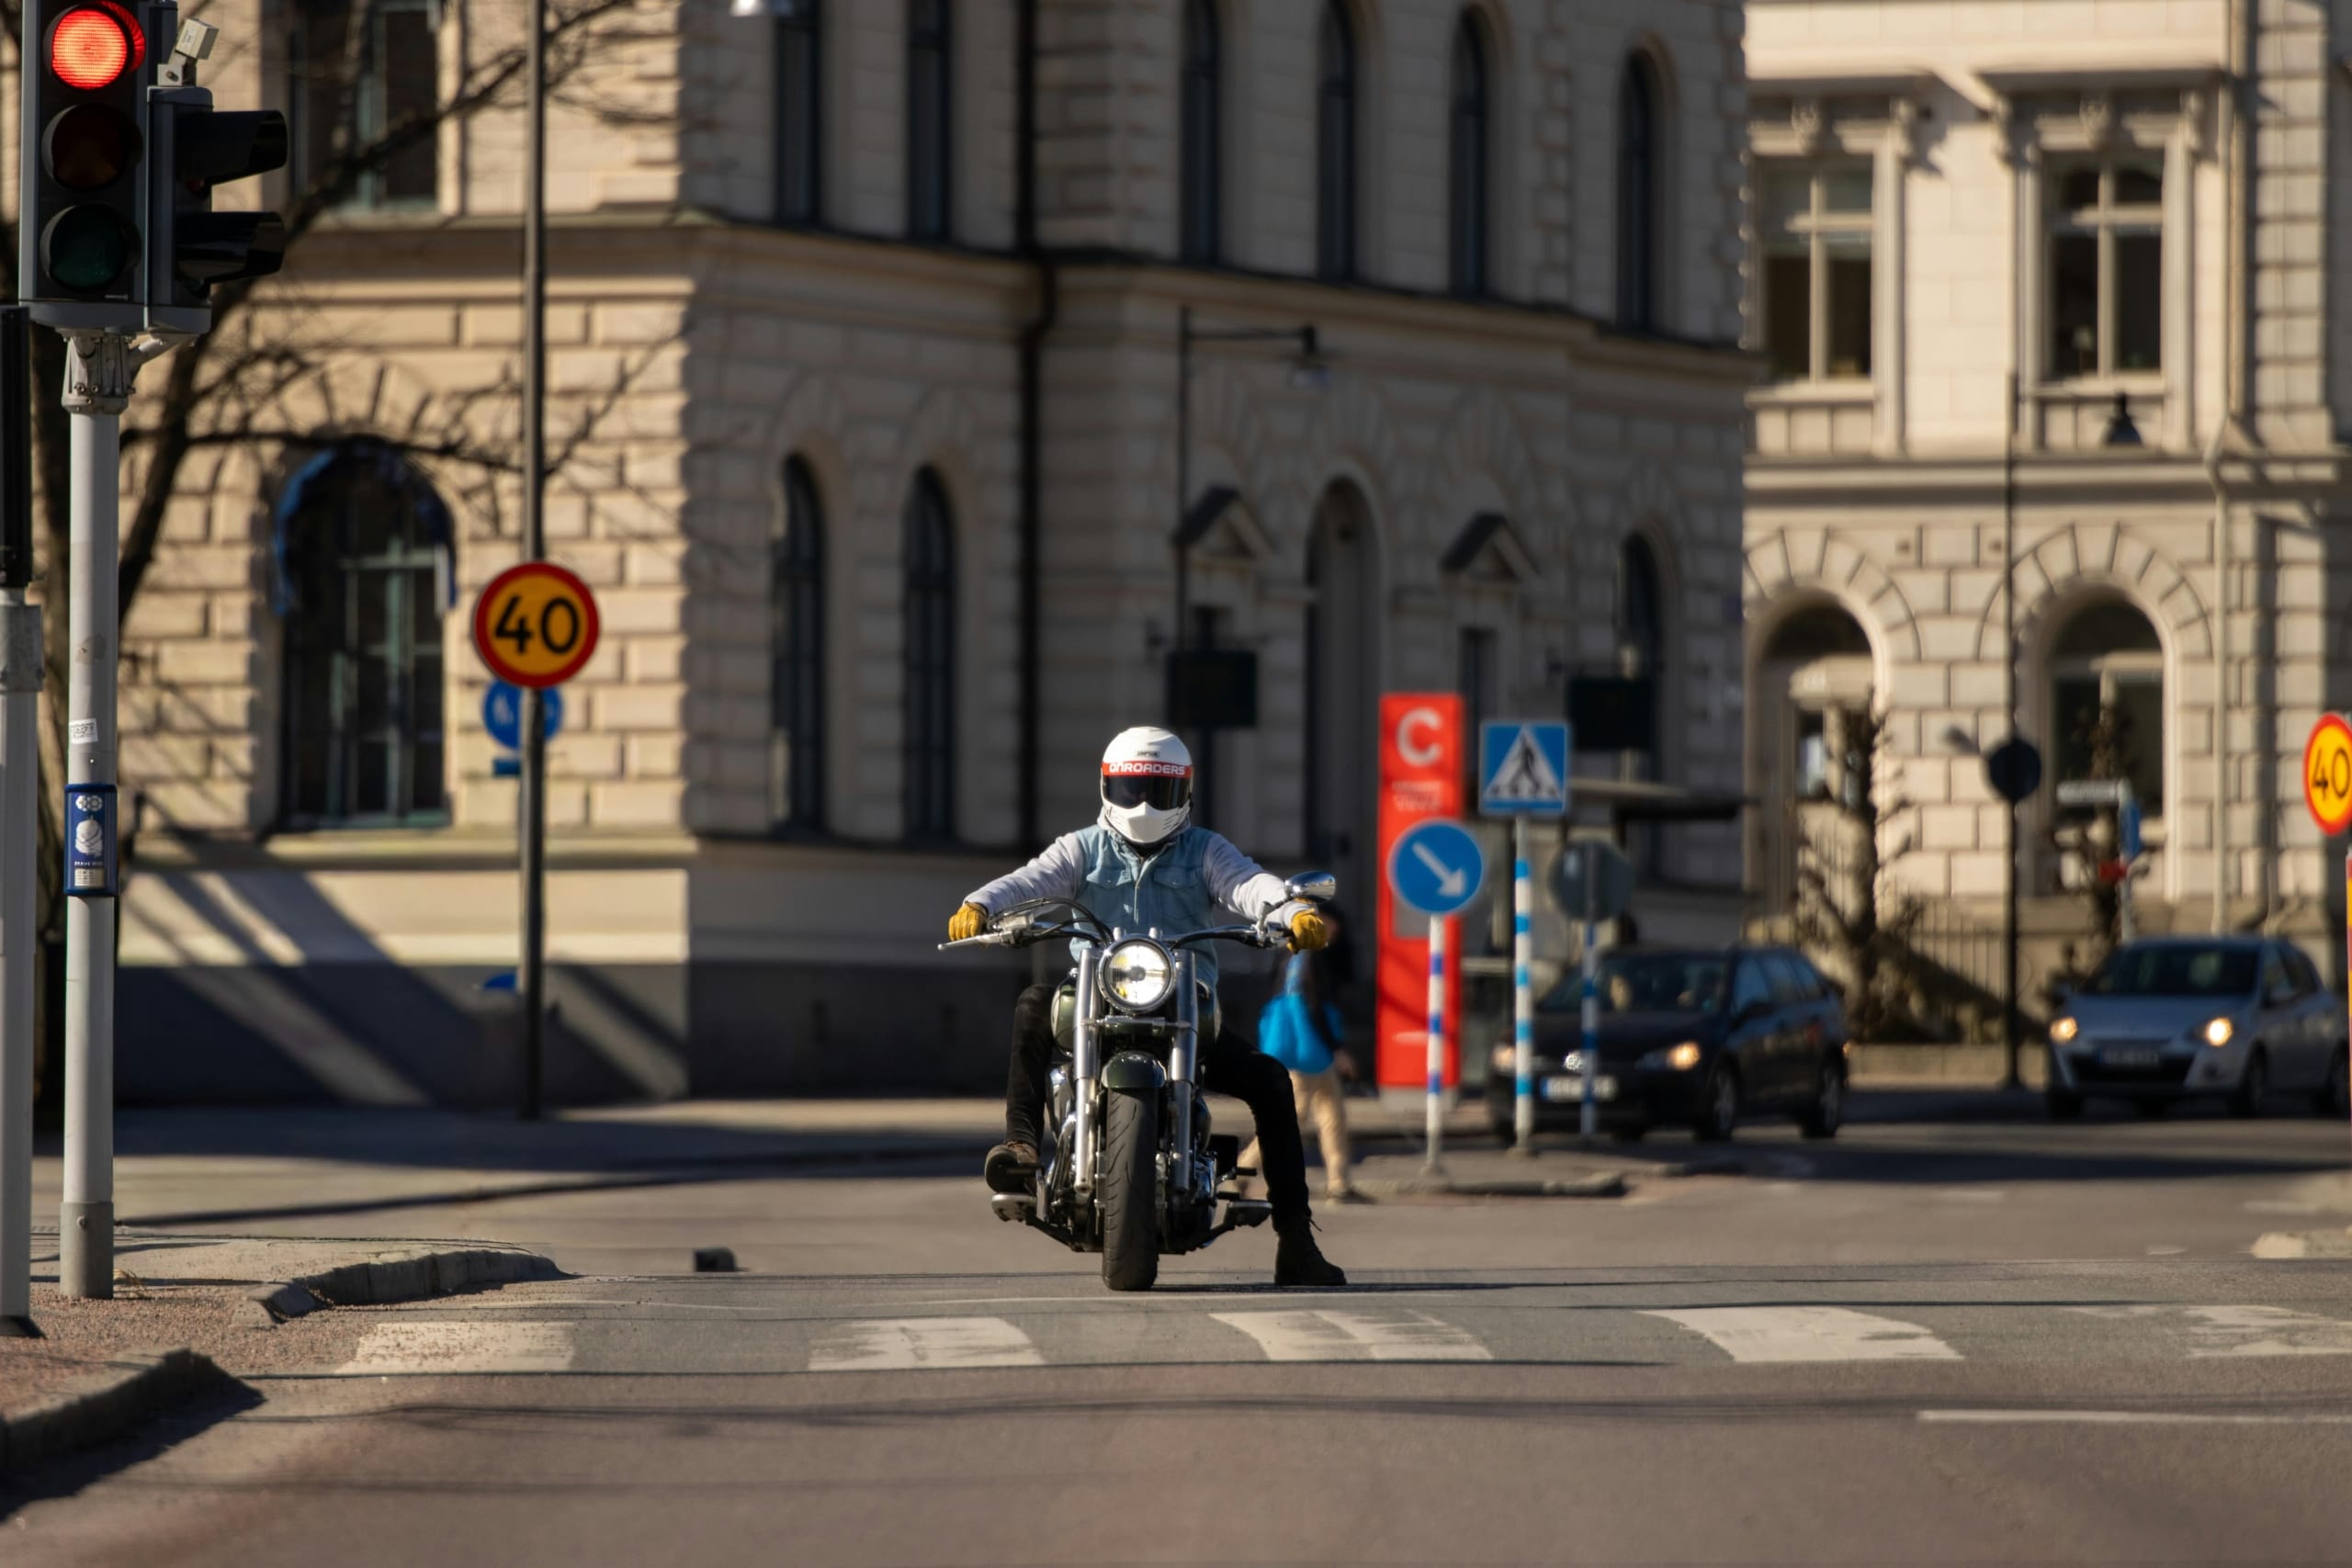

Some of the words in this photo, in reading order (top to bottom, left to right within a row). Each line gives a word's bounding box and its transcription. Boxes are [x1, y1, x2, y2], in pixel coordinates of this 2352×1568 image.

[495, 595, 579, 654] 40
[1396, 706, 1442, 766] C
[2312, 747, 2350, 801] 40
